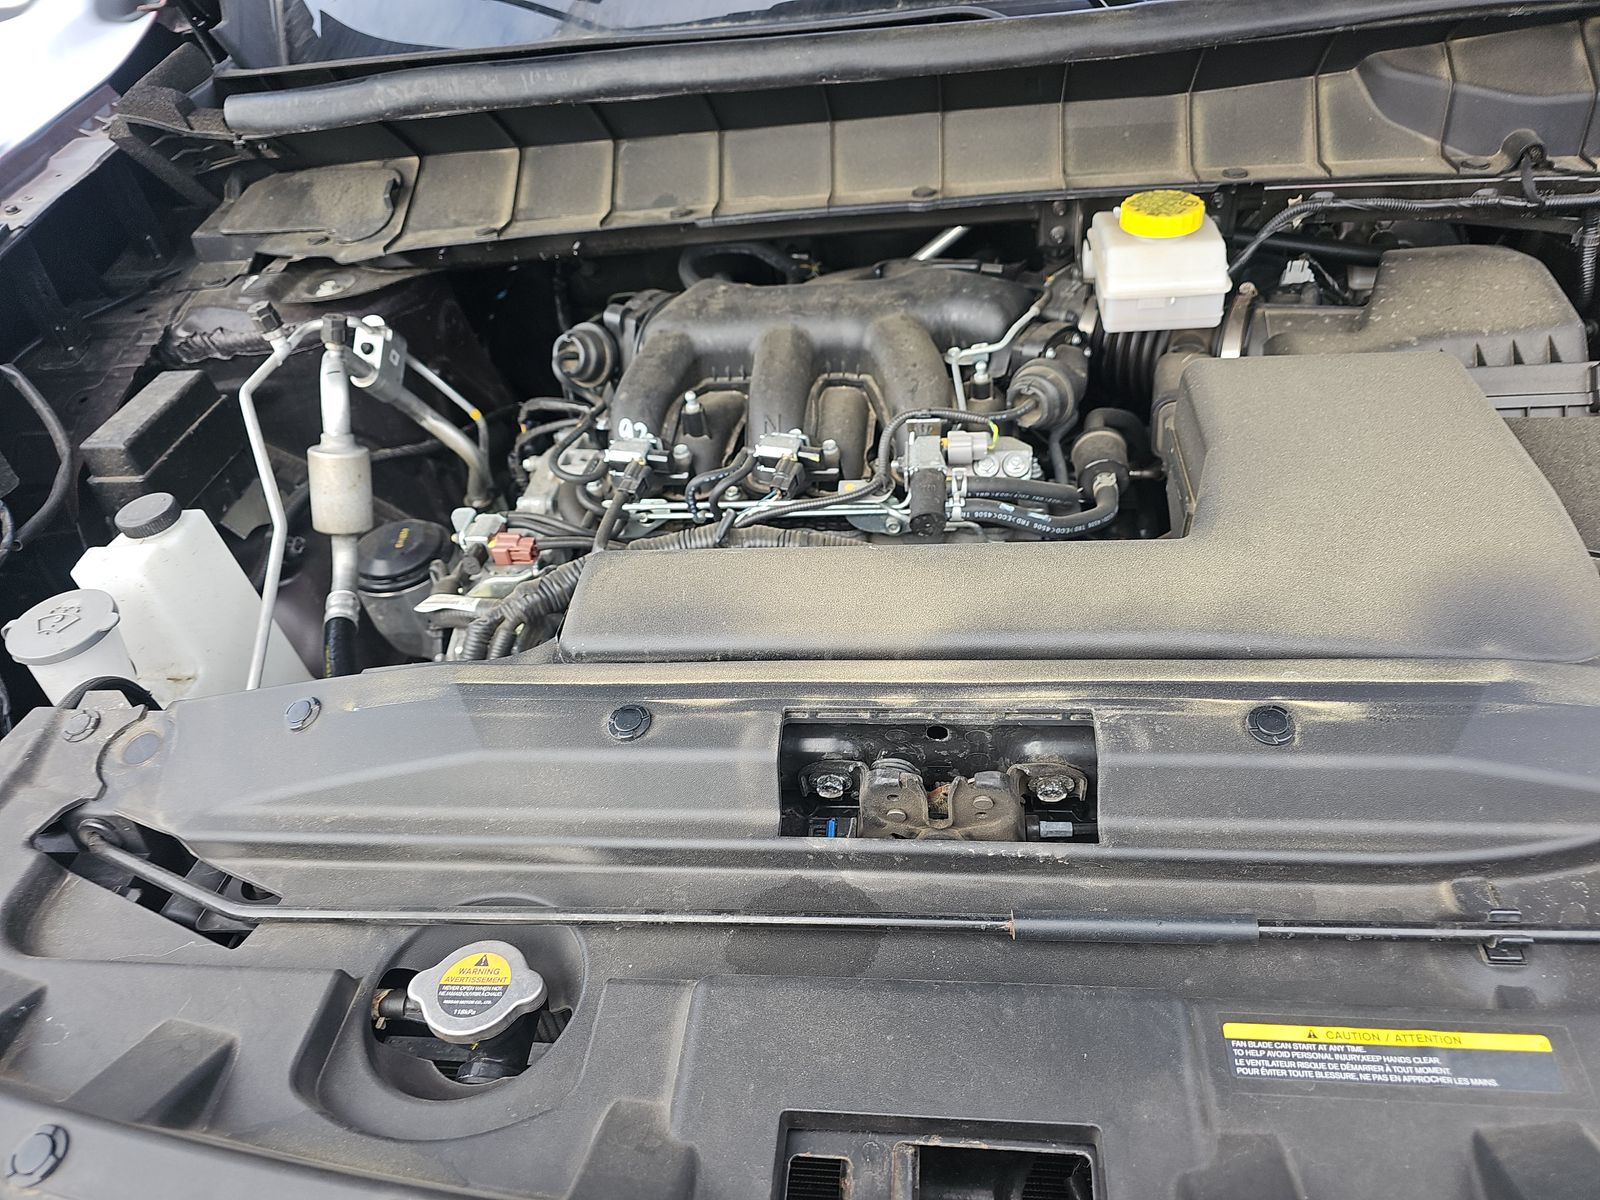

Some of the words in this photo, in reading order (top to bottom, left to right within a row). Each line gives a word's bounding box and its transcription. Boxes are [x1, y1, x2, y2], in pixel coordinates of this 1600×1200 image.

[458, 967, 501, 975] WARNING
[1326, 1031, 1381, 1042] CAUTION
[1395, 1033, 1462, 1045] ATTENTION
[1231, 1040, 1247, 1048] FAN
[1247, 1041, 1274, 1049] BLADE
[1274, 1042, 1292, 1050] CAN
[1292, 1042, 1317, 1051] START
[1318, 1043, 1328, 1051] AT
[1329, 1044, 1345, 1052] ANY
[1345, 1045, 1367, 1053] TIME.
[1233, 1048, 1244, 1056] TO
[1245, 1049, 1266, 1057] HELP
[1266, 1050, 1290, 1058] AVOID
[1291, 1051, 1334, 1060] PERSONAL
[1382, 1055, 1412, 1064] HANDS
[1412, 1056, 1442, 1064] CLEAR.
[1235, 1058, 1245, 1066] LE
[1245, 1059, 1297, 1069] VENTILATEUR
[1297, 1061, 1327, 1070] RISQUE
[1327, 1063, 1340, 1071] DE
[1340, 1062, 1385, 1072] DÉMARRER
[1385, 1063, 1392, 1073] À
[1392, 1066, 1413, 1074] TOUT
[1415, 1066, 1452, 1076] MOMENT.
[1236, 1067, 1260, 1076] POUR
[1260, 1066, 1287, 1077] ÉVITER
[1288, 1069, 1314, 1078] TOUTE
[1372, 1073, 1388, 1082] PAS
[1402, 1075, 1453, 1084] APPROCHER
[1454, 1077, 1470, 1085] LES
[1470, 1078, 1499, 1087] MAINS.
